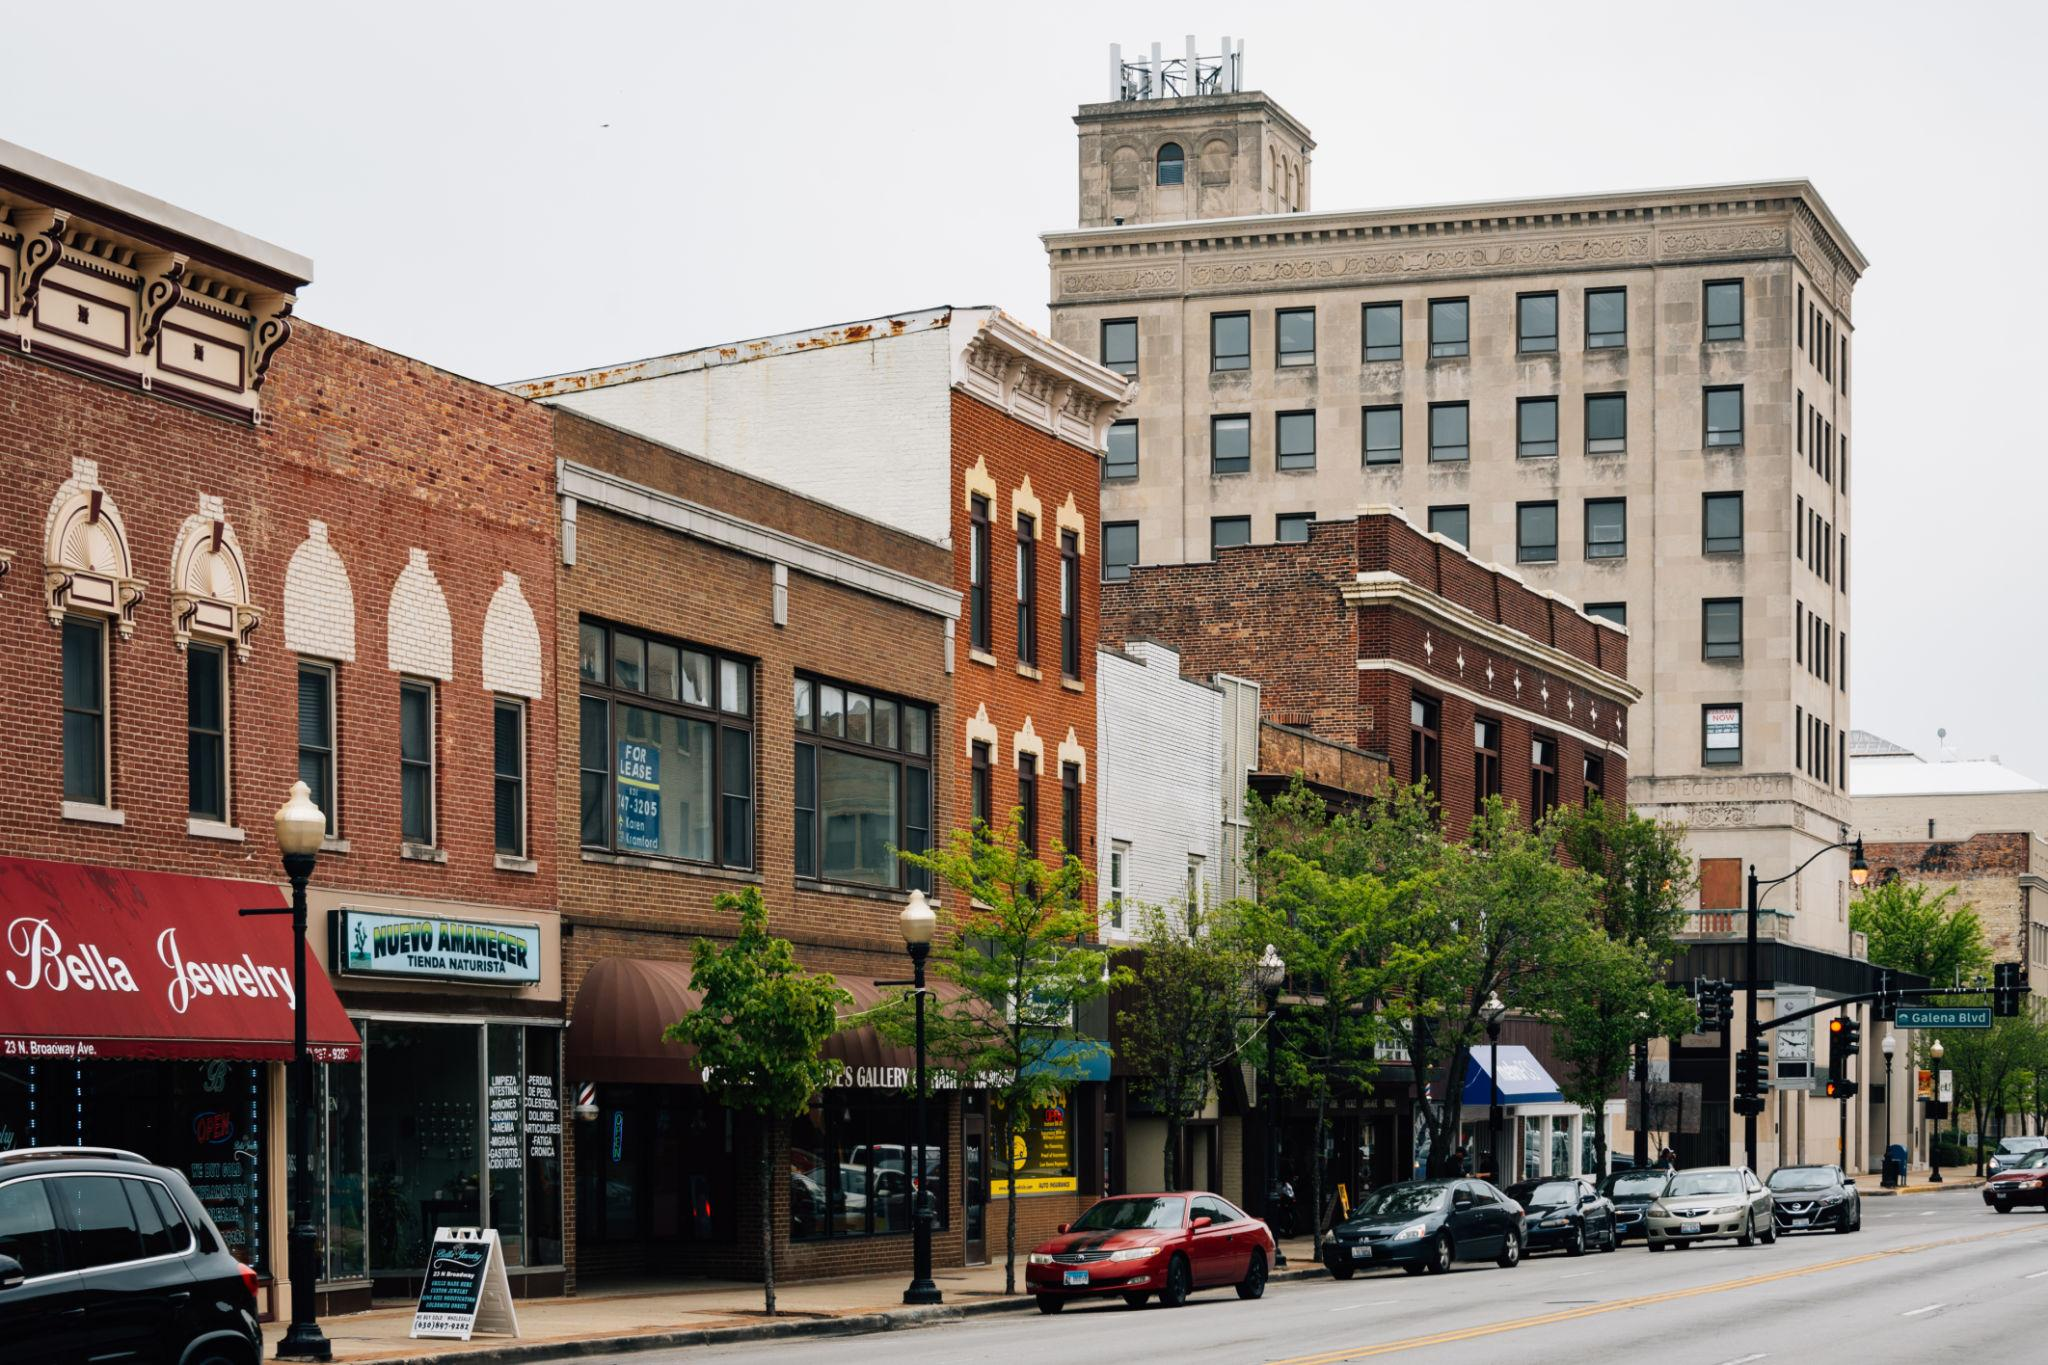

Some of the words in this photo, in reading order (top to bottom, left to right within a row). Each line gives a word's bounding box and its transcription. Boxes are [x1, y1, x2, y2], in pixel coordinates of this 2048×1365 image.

[625, 745, 647, 763] FOR
[620, 760, 652, 781] LEASE
[1657, 782, 1736, 797] ERECTED
[1744, 779, 1784, 795] 1926
[373, 921, 433, 958] NUEVO
[438, 922, 528, 969] AMANECER
[6, 917, 140, 992] Bella
[157, 927, 297, 1014] Jewelry
[407, 954, 446, 969] TIENDA
[450, 957, 506, 973] NATURISTA
[1912, 1013, 1955, 1023] Galena
[1959, 1012, 1986, 1023] Blvd
[5, 1040, 16, 1054] 23
[18, 1040, 29, 1054] N.
[30, 1041, 75, 1058] Broadway
[78, 1042, 97, 1055] Ave.
[491, 1076, 517, 1086] LIMPIEZA
[857, 1066, 909, 1088] GALLERY
[489, 1086, 520, 1096] INTESTINAL
[528, 1087, 536, 1096] DE
[537, 1088, 551, 1098] PESO
[525, 1098, 559, 1110] COLESTEROL
[529, 1111, 554, 1121] DOLORES
[197, 1113, 230, 1144] OPEN
[525, 1124, 560, 1134] ARTICULARES
[531, 1147, 555, 1157] CRONICA
[446, 1271, 475, 1279] Broadway
